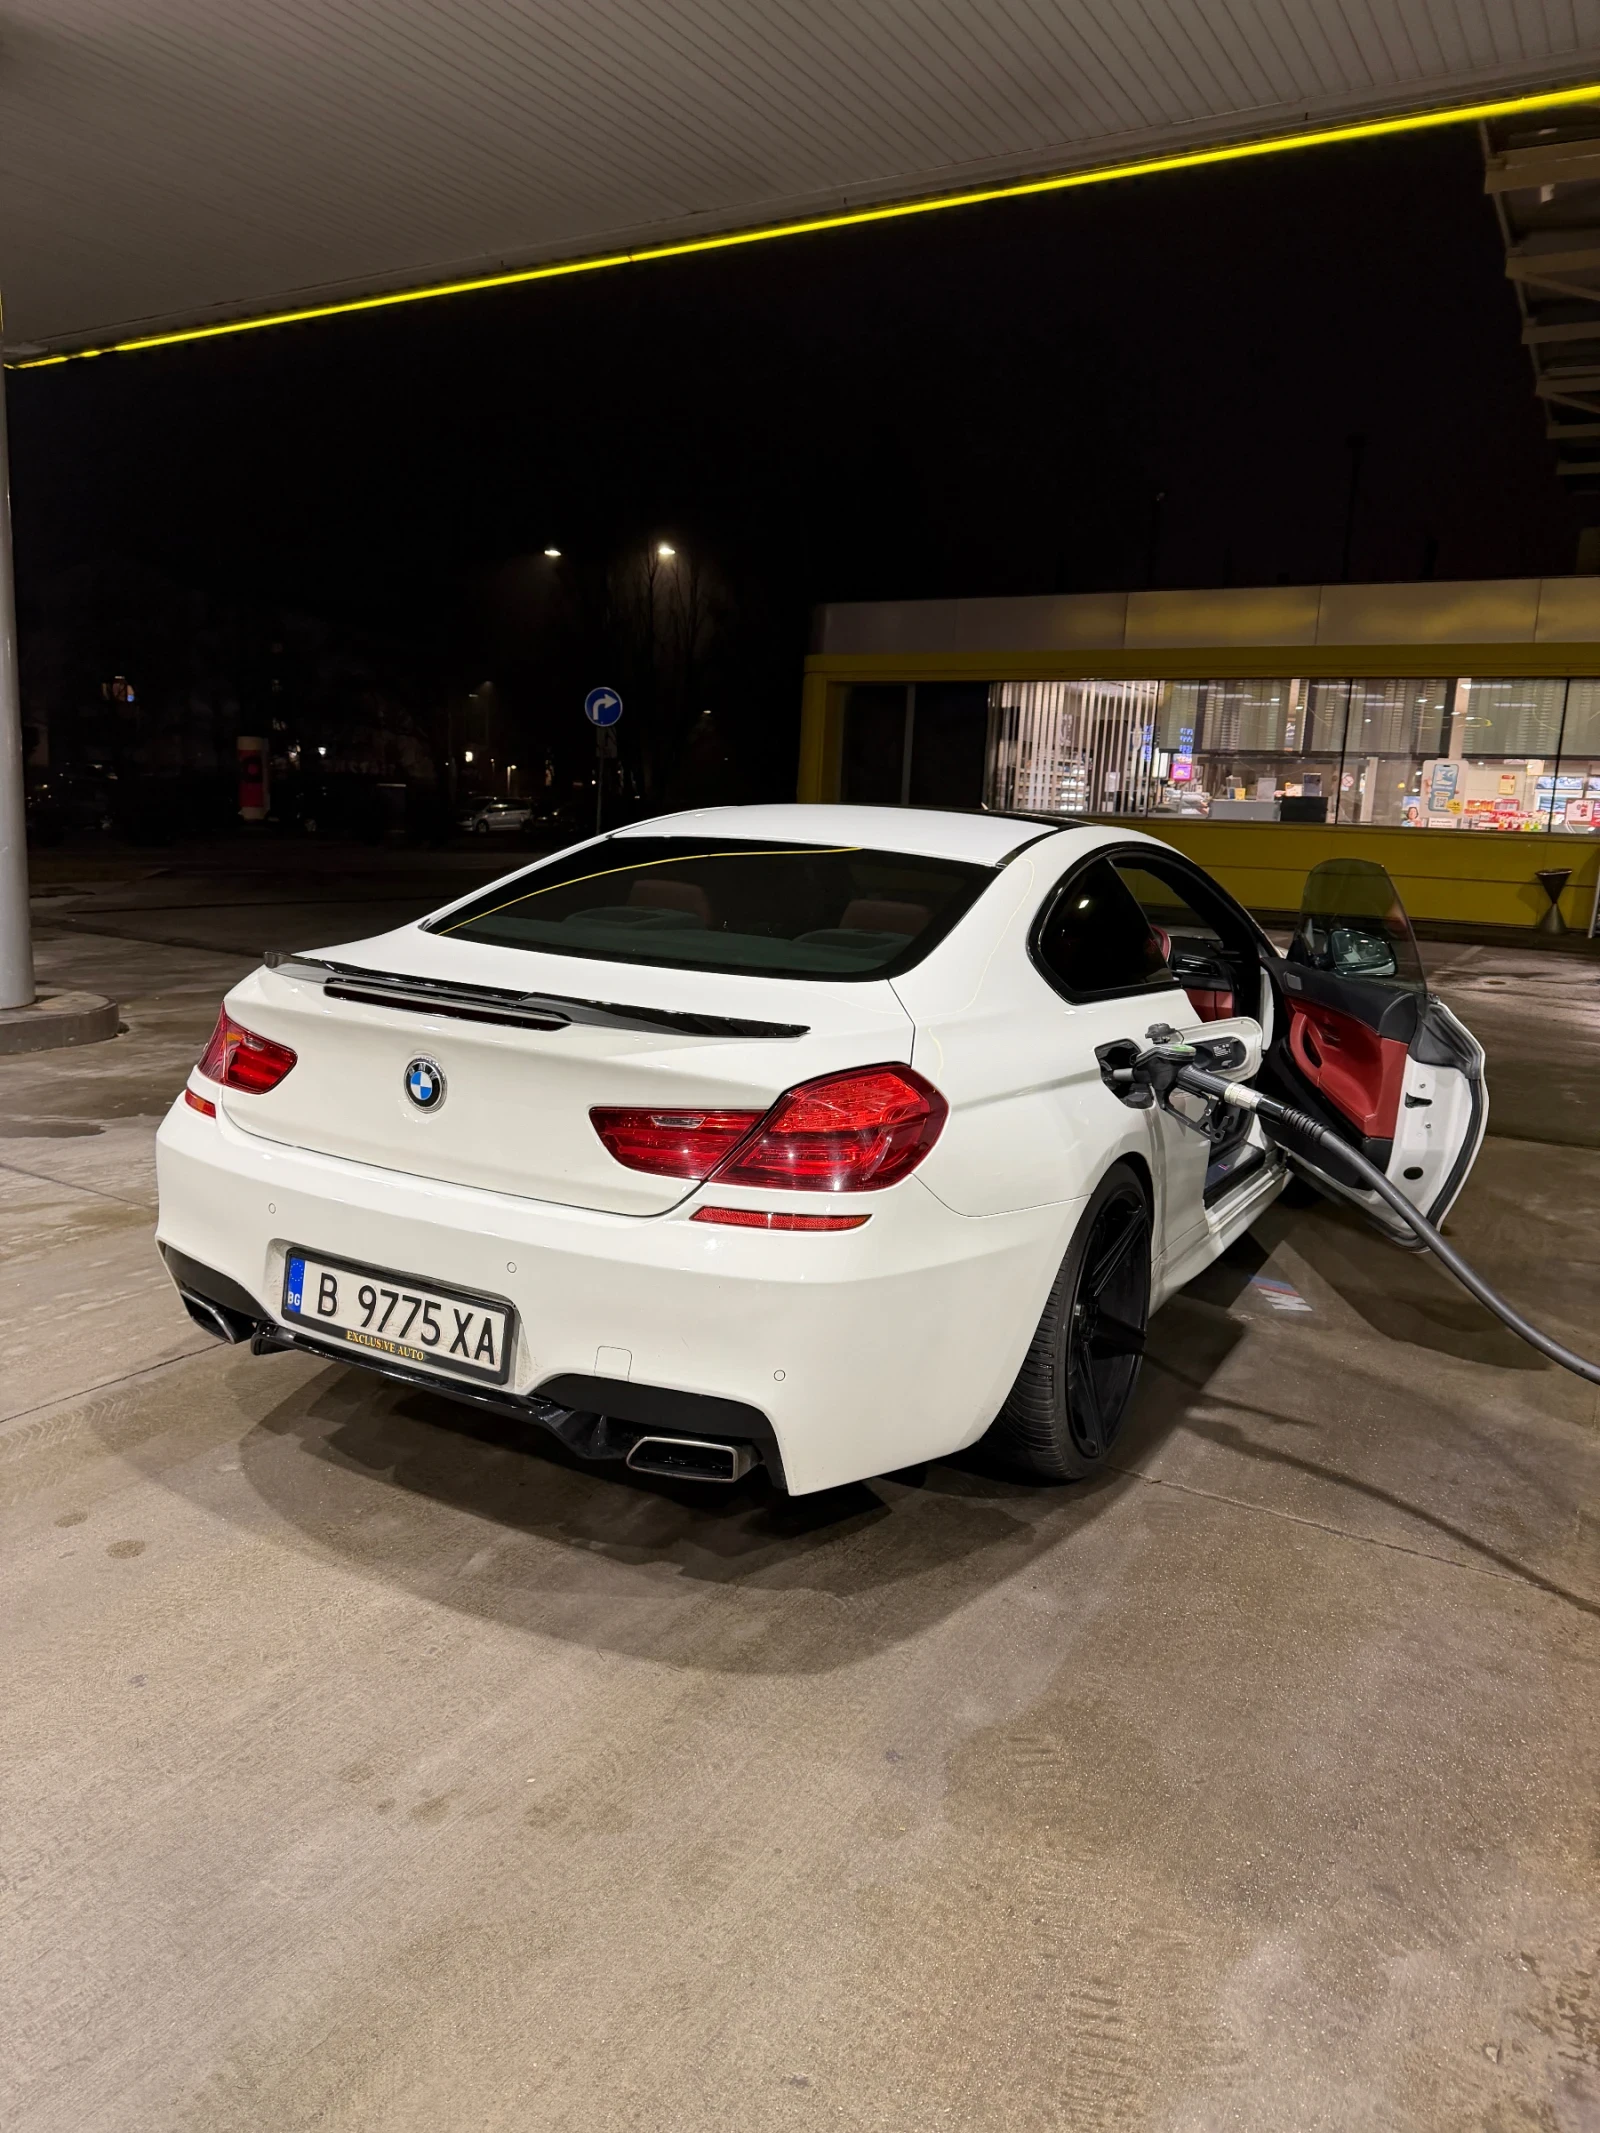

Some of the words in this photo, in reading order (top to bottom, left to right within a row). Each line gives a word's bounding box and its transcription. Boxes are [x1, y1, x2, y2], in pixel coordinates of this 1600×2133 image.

[408, 1063, 438, 1080] BMW
[287, 1291, 301, 1306] BG
[317, 1272, 338, 1317] B
[357, 1284, 442, 1346] 9775
[449, 1308, 495, 1365] XA
[346, 1330, 396, 1354] EXCLUSIVE
[397, 1346, 424, 1361] AUTO
